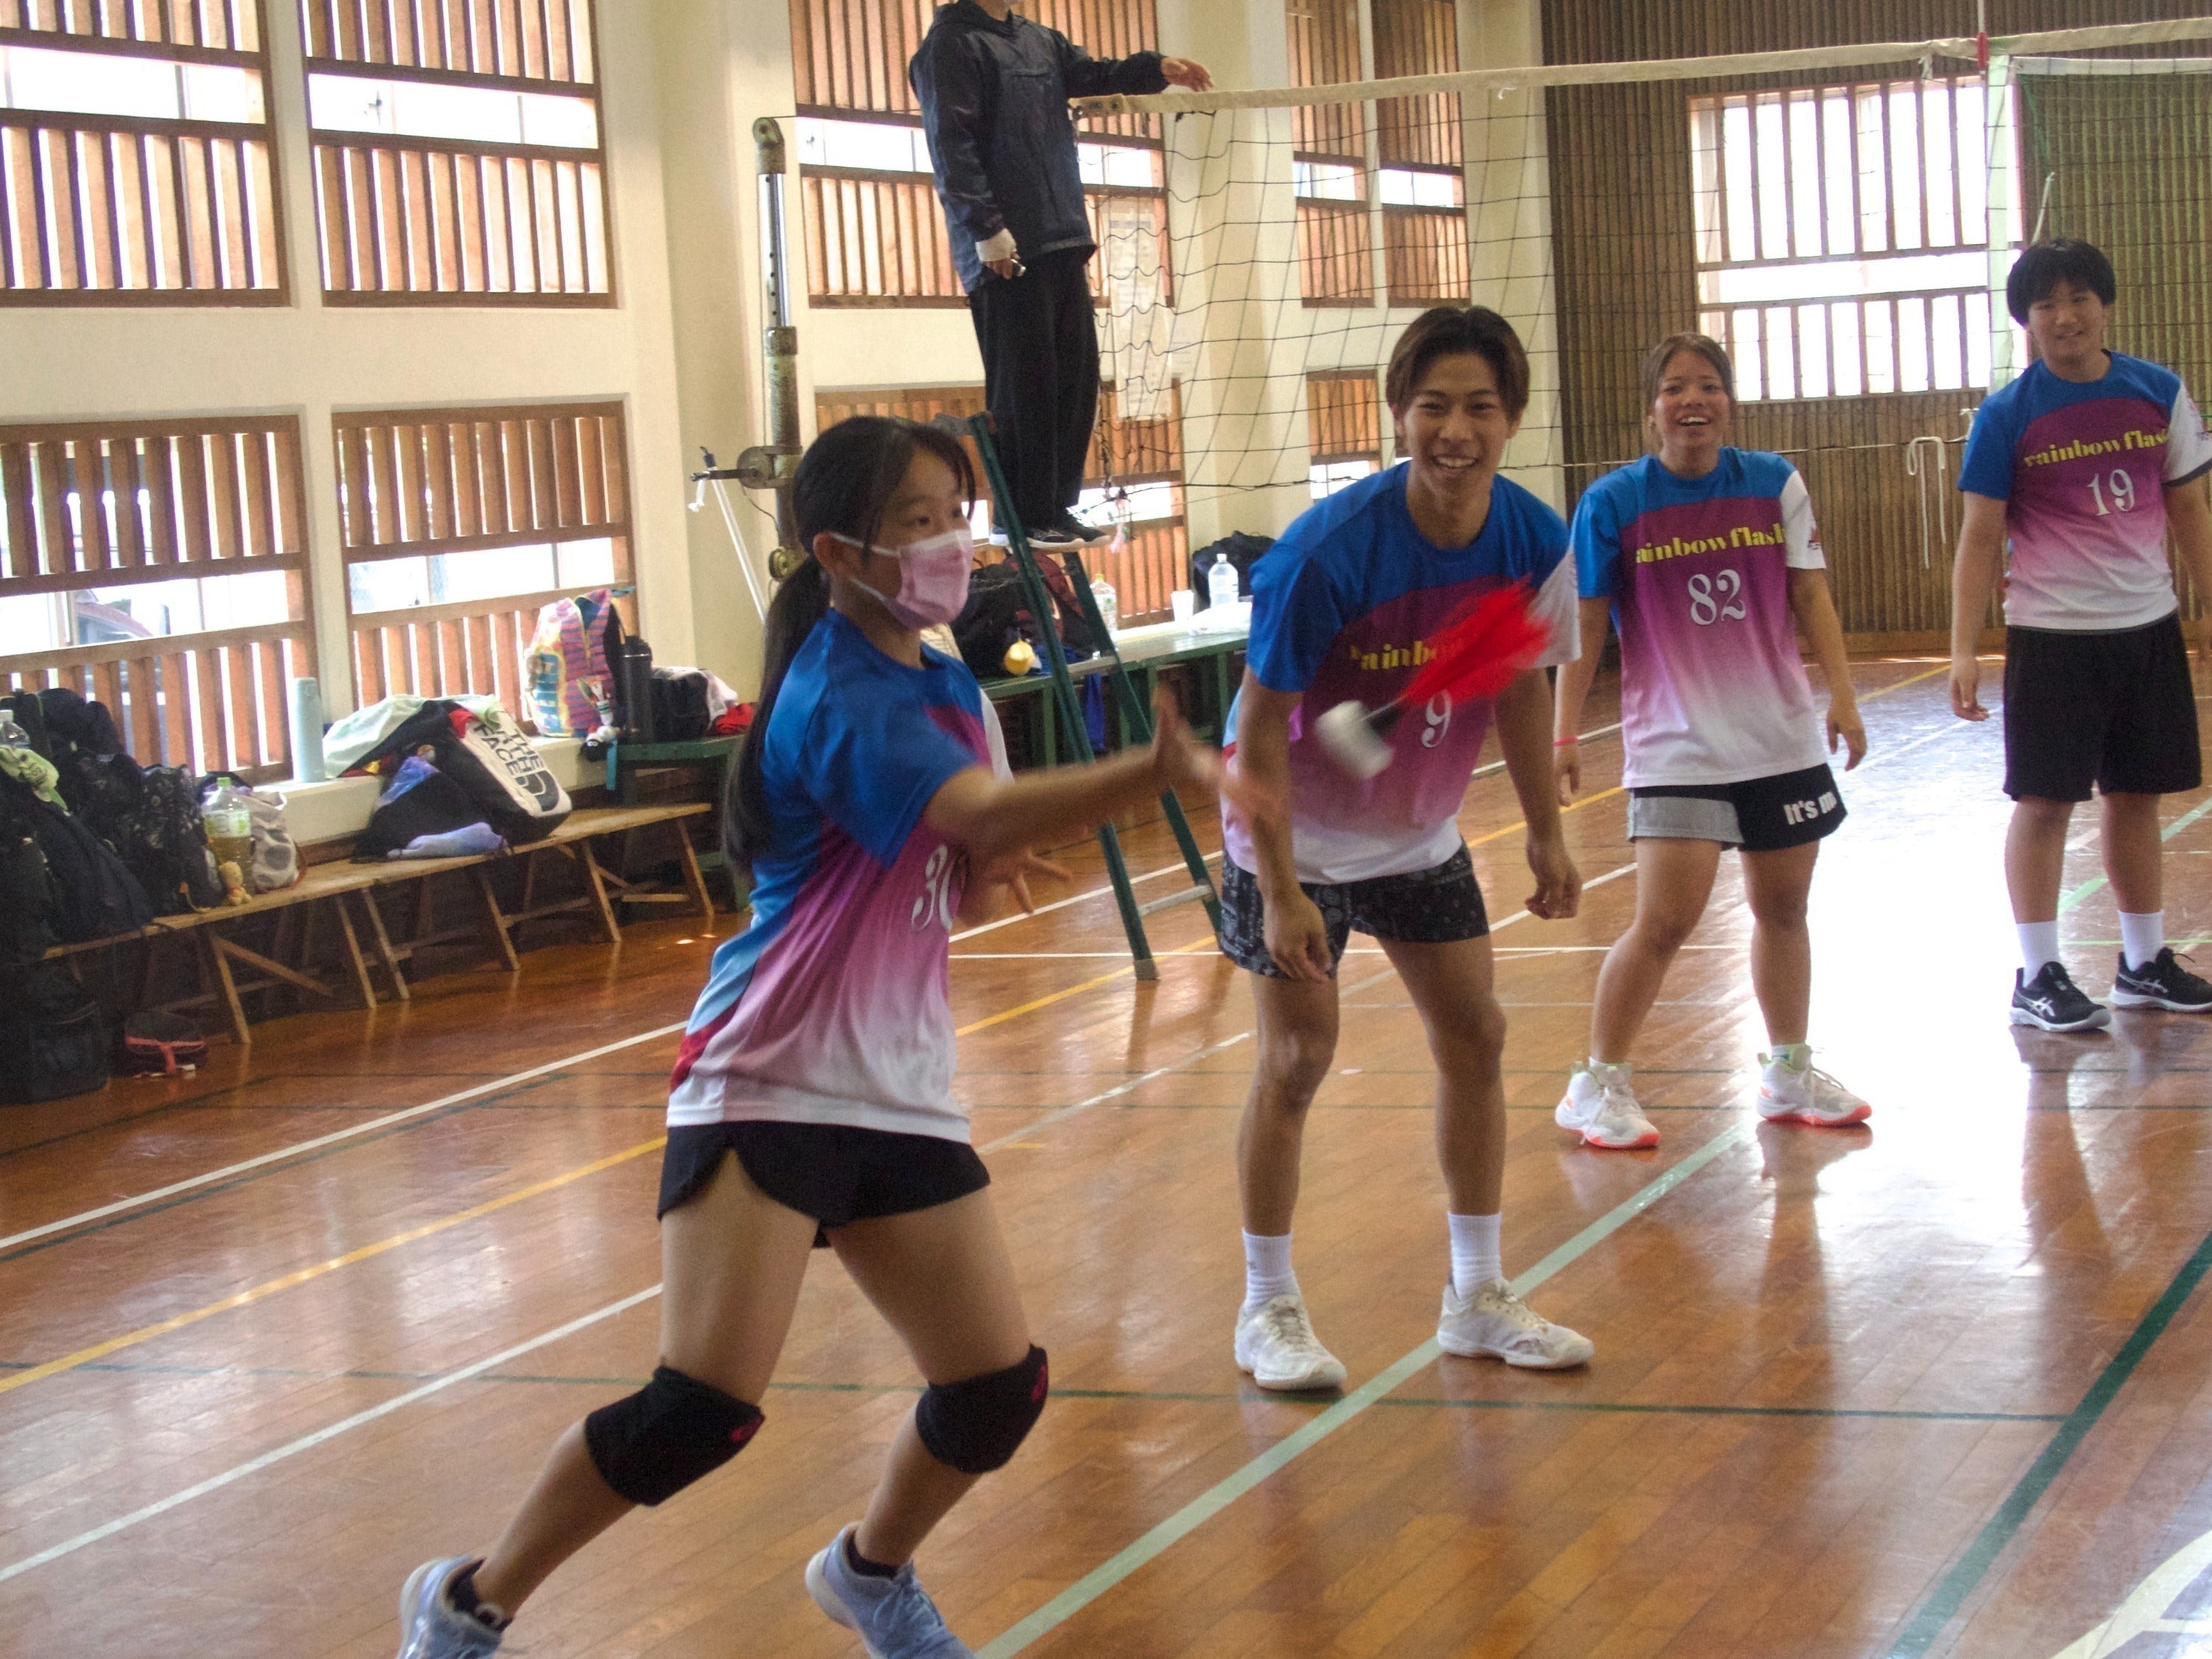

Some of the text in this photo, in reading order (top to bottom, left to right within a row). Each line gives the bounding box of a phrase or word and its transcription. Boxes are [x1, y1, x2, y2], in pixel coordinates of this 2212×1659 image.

[2024, 439, 2121, 467] rainbow
[2087, 468, 2135, 516] 19
[1635, 536, 1727, 564] ainbow
[1688, 568, 1746, 625] 82
[1422, 689, 1453, 748] 9
[473, 723, 521, 776] FACE
[510, 728, 544, 768] THE
